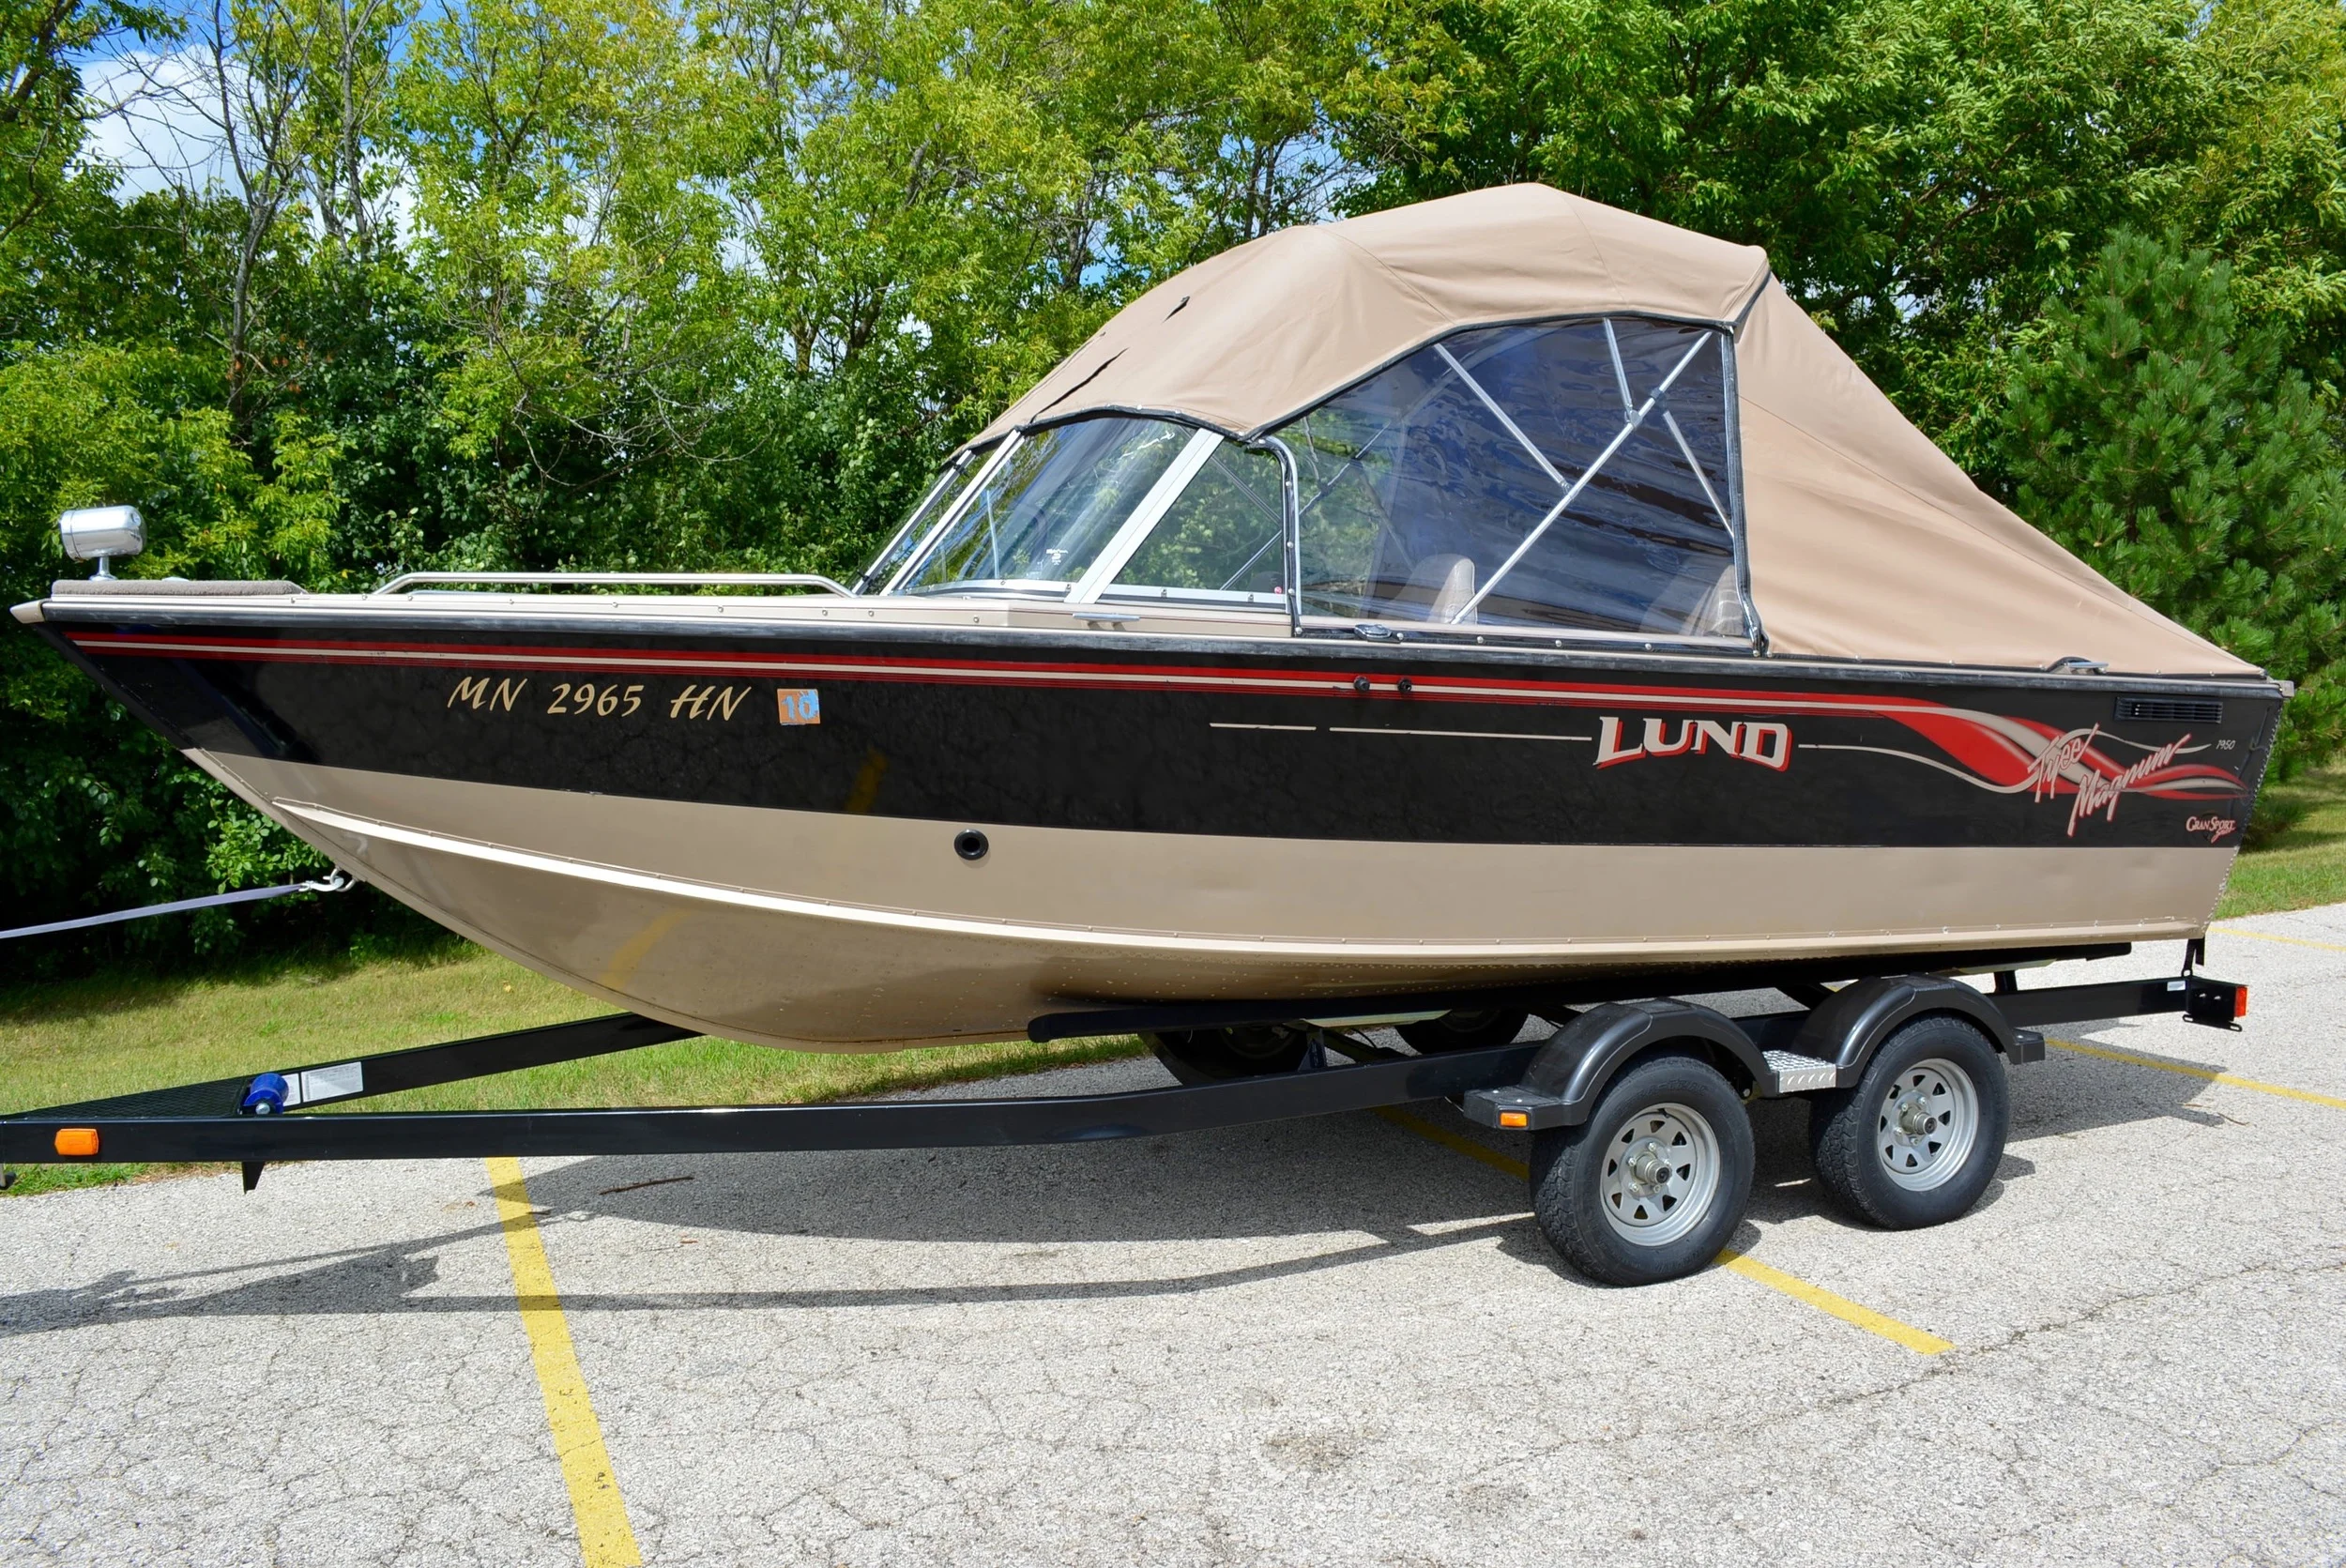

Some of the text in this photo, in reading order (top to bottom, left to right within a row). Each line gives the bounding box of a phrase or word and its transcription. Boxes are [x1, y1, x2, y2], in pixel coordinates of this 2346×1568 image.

[448, 677, 752, 722] MN 2965 HN
[1592, 716, 1793, 771] LUND
[2027, 722, 2100, 803] Tyee
[2216, 738, 2237, 751] 1950
[2067, 733, 2192, 838] Magnum
